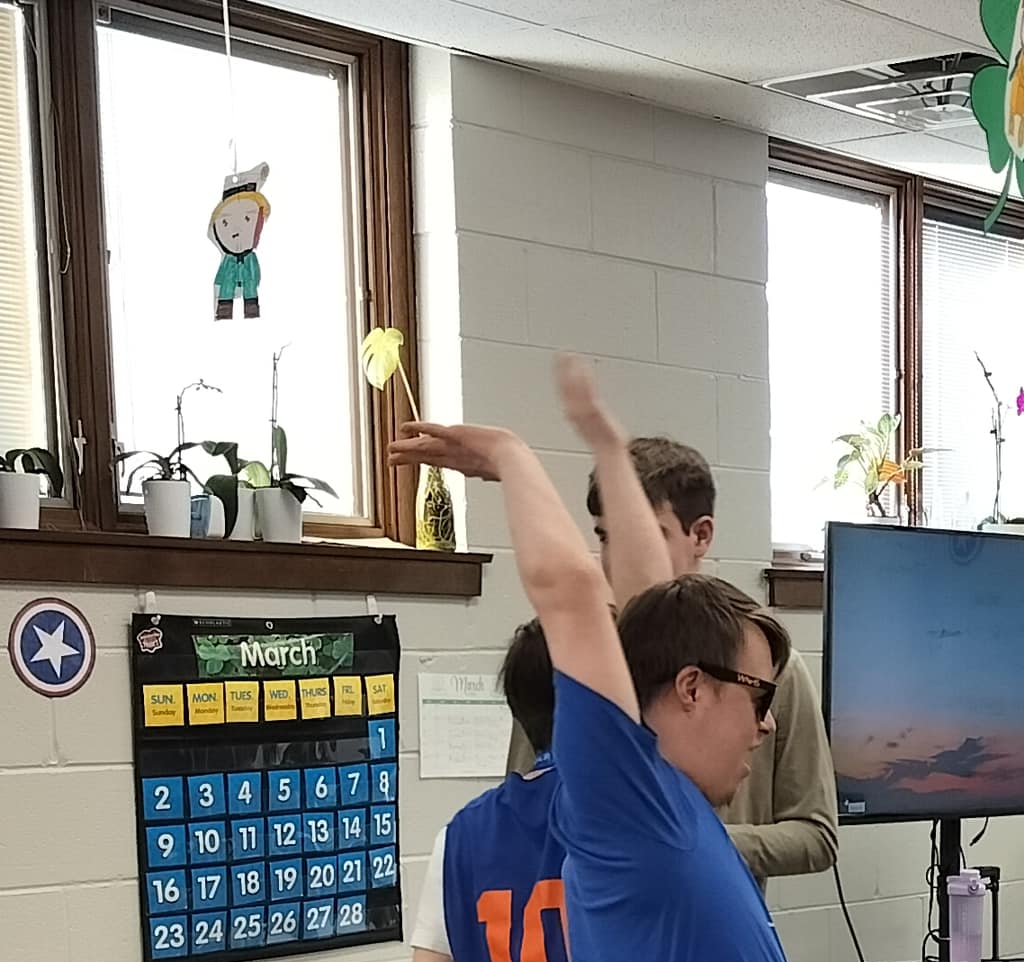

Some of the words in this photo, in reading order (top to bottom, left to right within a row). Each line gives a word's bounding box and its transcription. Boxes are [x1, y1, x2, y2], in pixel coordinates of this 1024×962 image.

[241, 640, 317, 669] March
[378, 727, 386, 750] 1
[153, 786, 171, 810] 2
[199, 783, 214, 807] 3
[237, 780, 252, 804] 4
[277, 778, 291, 801] 5
[315, 775, 328, 799] 6
[348, 772, 361, 795] 7
[379, 771, 391, 793] 8
[157, 833, 175, 859] 9
[194, 829, 220, 855] 10
[239, 826, 256, 850] 11
[273, 822, 296, 847] 12
[308, 819, 329, 843] 13
[342, 816, 361, 840] 14
[374, 812, 392, 837] 15
[152, 877, 180, 904] 16
[197, 875, 221, 901] 17
[236, 870, 260, 896] 18
[274, 866, 297, 892] 19
[310, 864, 335, 889] 20
[343, 859, 362, 884] 21
[373, 853, 394, 880] 22
[154, 923, 185, 950] 23
[195, 919, 224, 946] 24
[233, 913, 261, 940] 25
[270, 910, 296, 936] 26
[306, 905, 332, 931] 27
[339, 902, 363, 927] 28
